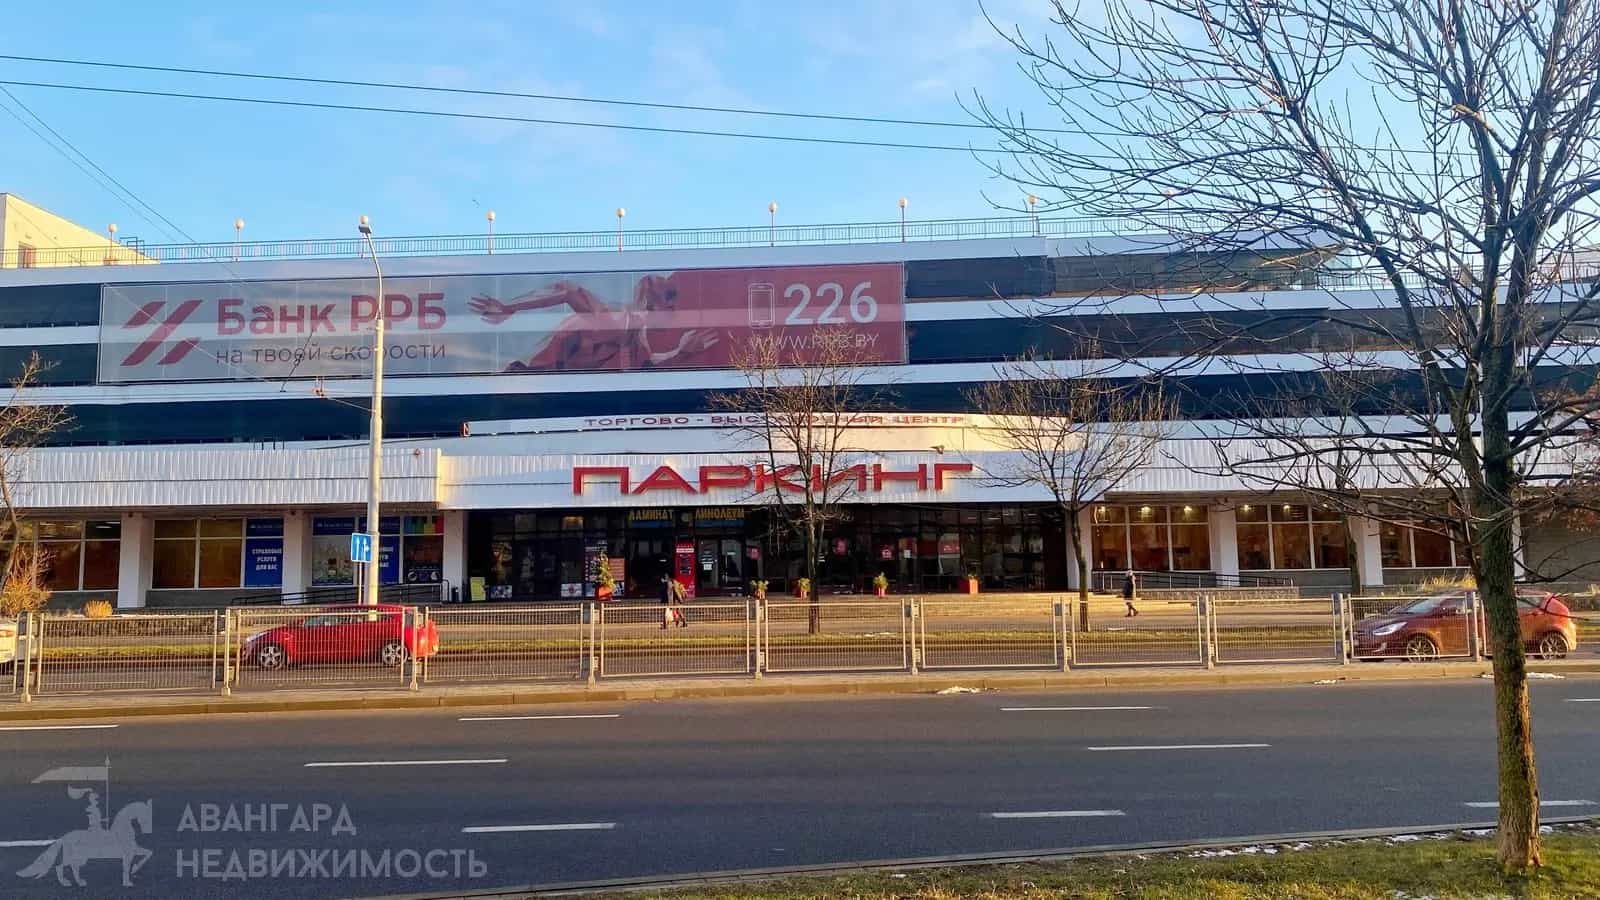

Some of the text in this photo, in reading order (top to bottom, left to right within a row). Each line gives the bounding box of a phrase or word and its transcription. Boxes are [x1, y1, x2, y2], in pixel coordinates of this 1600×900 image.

[217, 293, 447, 336] Банк РРБ
[783, 281, 878, 325] 226
[215, 351, 243, 364] на
[330, 343, 446, 361] скоости
[584, 416, 689, 427] ТОРГОВО
[711, 414, 883, 425] ВЫСАОЧНЫЙ
[893, 415, 964, 425] ЦЕНТР
[572, 463, 973, 496] ПАРКИНГ
[628, 509, 675, 521] ЛАМИНАТ
